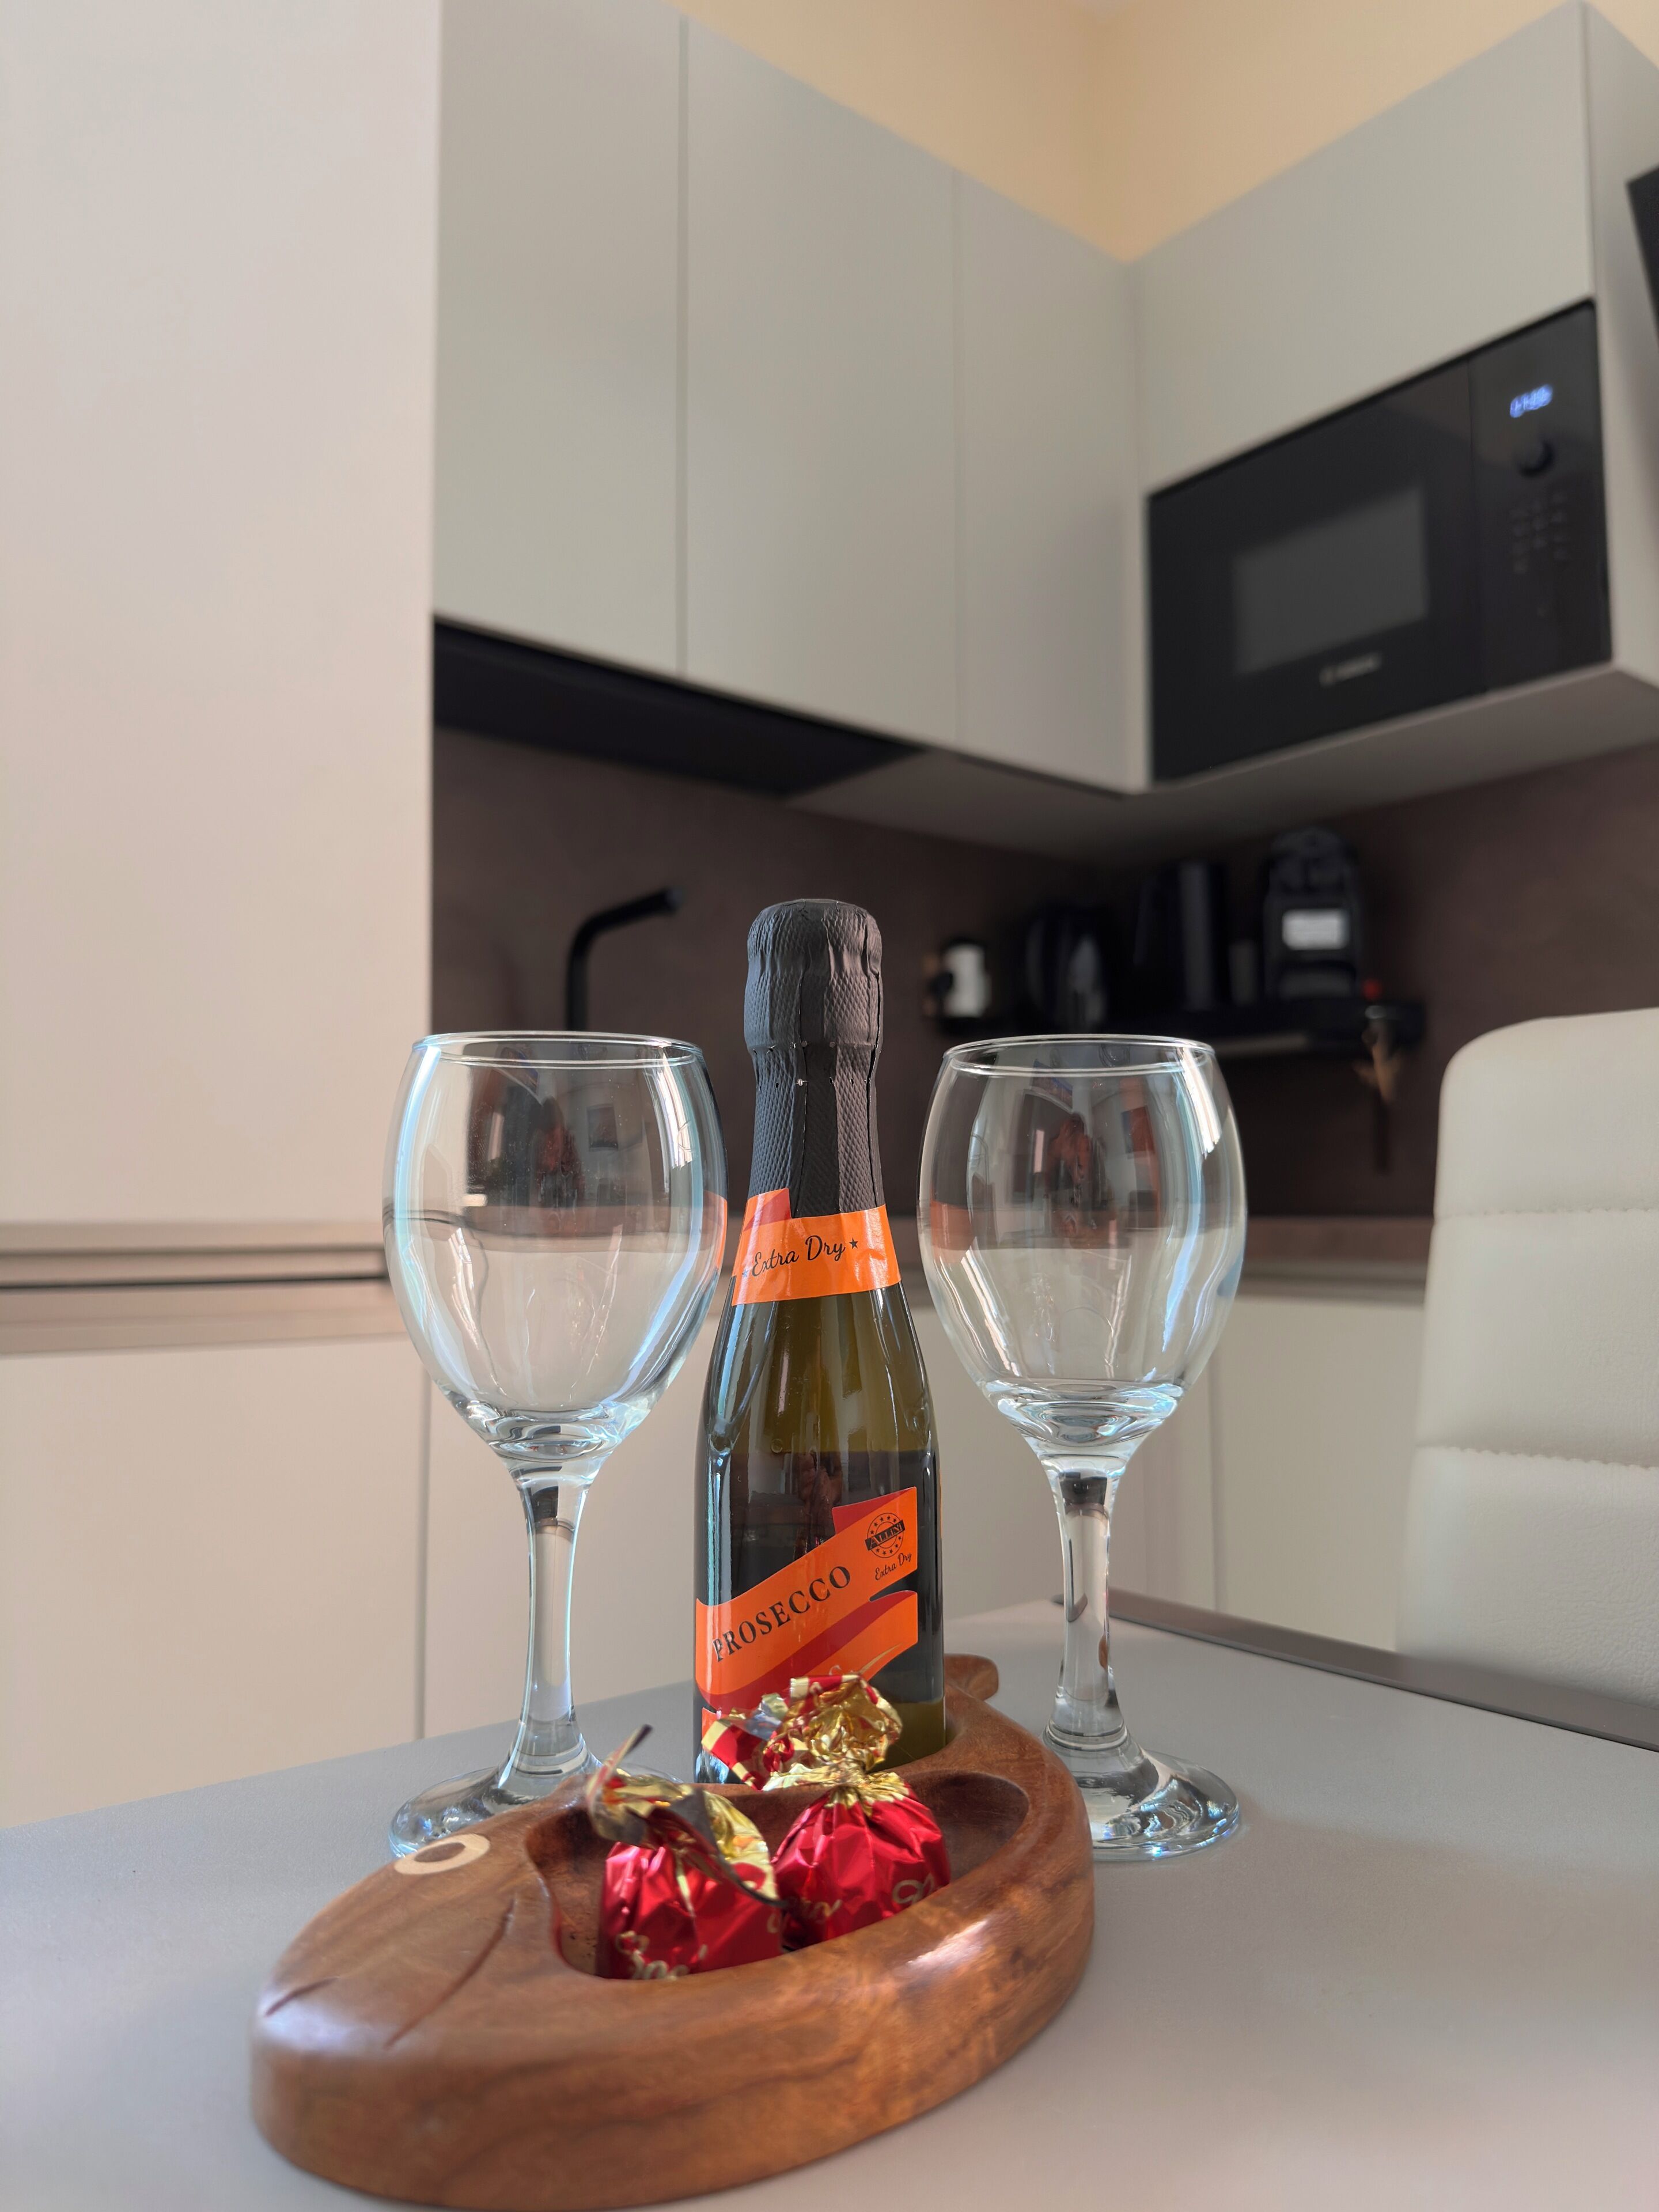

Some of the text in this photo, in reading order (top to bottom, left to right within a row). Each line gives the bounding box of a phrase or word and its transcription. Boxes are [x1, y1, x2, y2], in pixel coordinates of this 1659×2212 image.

[752, 1235, 846, 1277] Extra Dry
[875, 1552, 912, 1581] Extra Dry
[712, 1566, 851, 1662] PROSECCO
